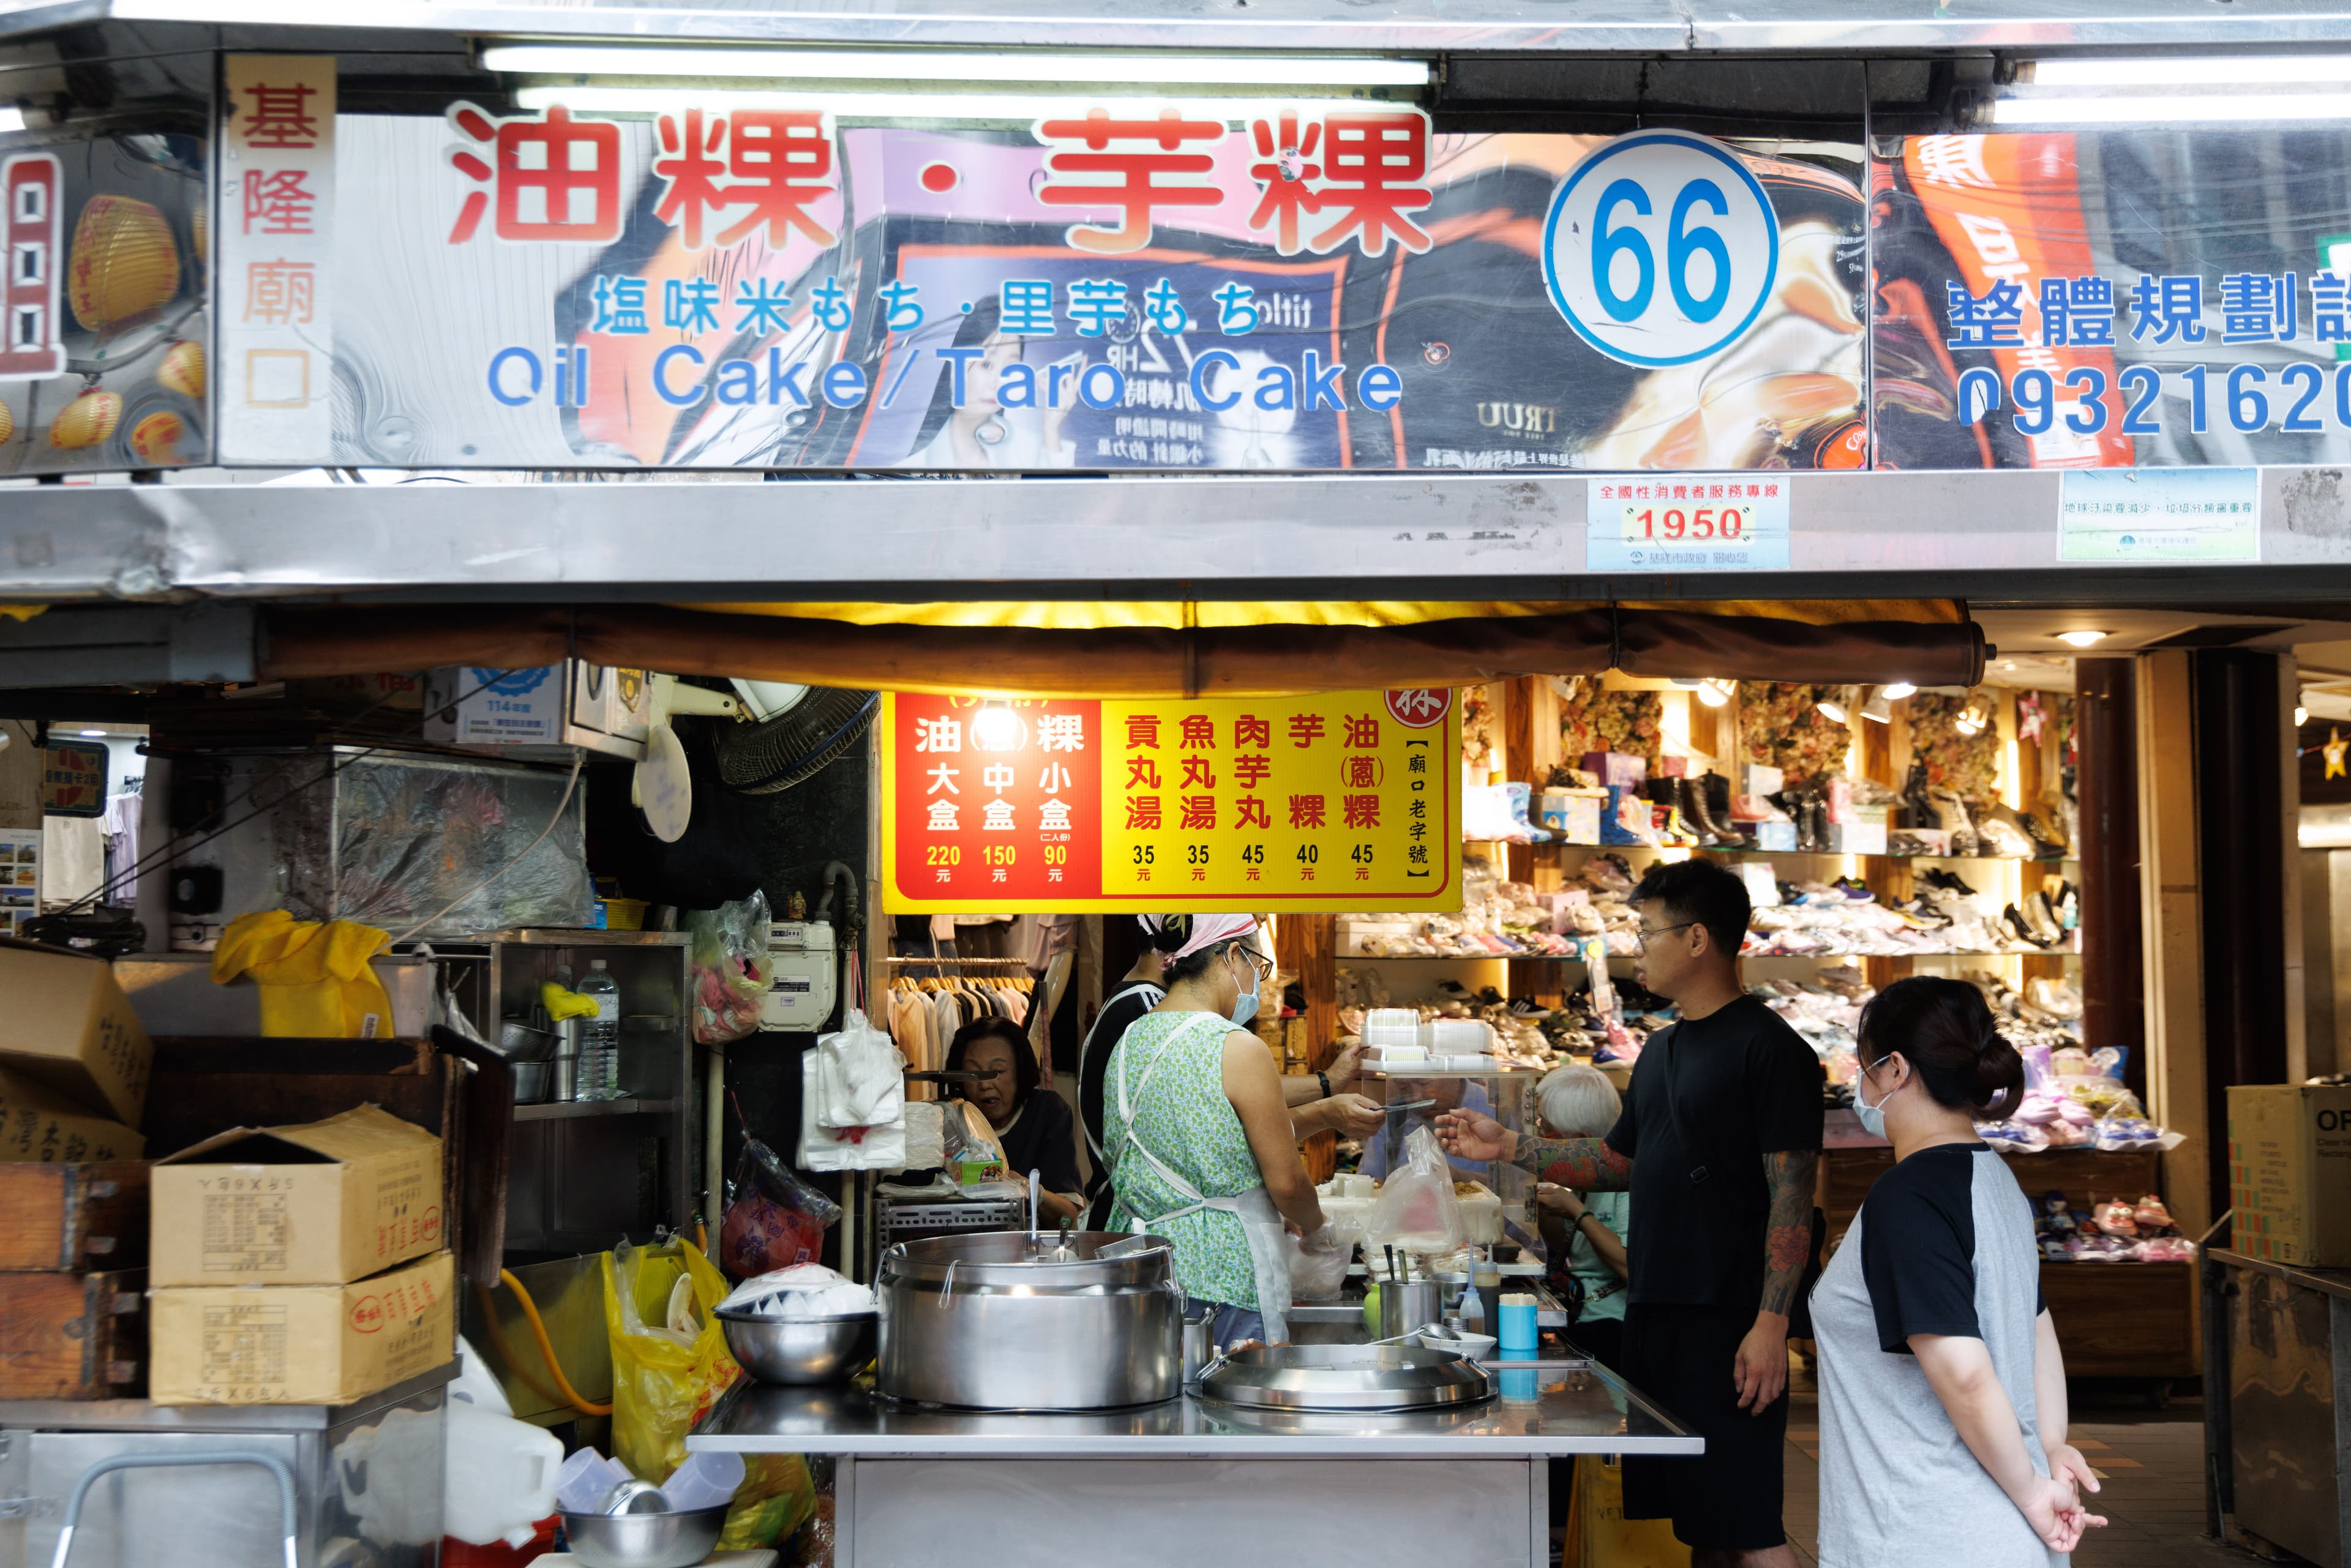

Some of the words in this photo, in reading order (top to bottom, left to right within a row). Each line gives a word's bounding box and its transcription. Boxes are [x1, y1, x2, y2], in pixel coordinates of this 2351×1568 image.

[243, 83, 317, 408] 基隆廟口
[1592, 179, 1731, 324] 66
[489, 347, 587, 407] Oil
[1190, 349, 1402, 411] Cake
[1599, 484, 1779, 500] 全國性消費者服務專線
[1636, 509, 1742, 541] 1950
[1125, 715, 1162, 830] 貢丸湯
[1179, 715, 1217, 830] 魚丸湯
[1234, 715, 1271, 830] 肉芋丸
[926, 762, 960, 831] 大盒
[983, 762, 1016, 831] 中盒
[1039, 762, 1072, 831] 小盒
[926, 846, 961, 866] 220
[983, 846, 1016, 866] 150
[1044, 846, 1067, 866] 90
[1133, 845, 1155, 864] 35
[1188, 845, 1209, 864] 35
[1242, 844, 1264, 864] 45
[1296, 844, 1318, 863] 40
[1351, 844, 1373, 863] 45
[936, 869, 951, 882] 元
[992, 869, 1007, 882] 元
[1048, 869, 1063, 882] 元
[1137, 868, 1150, 881] 元
[1191, 868, 1205, 881] 元
[1246, 868, 1260, 880] 元
[1301, 868, 1314, 880] 元
[1355, 868, 1369, 880] 元
